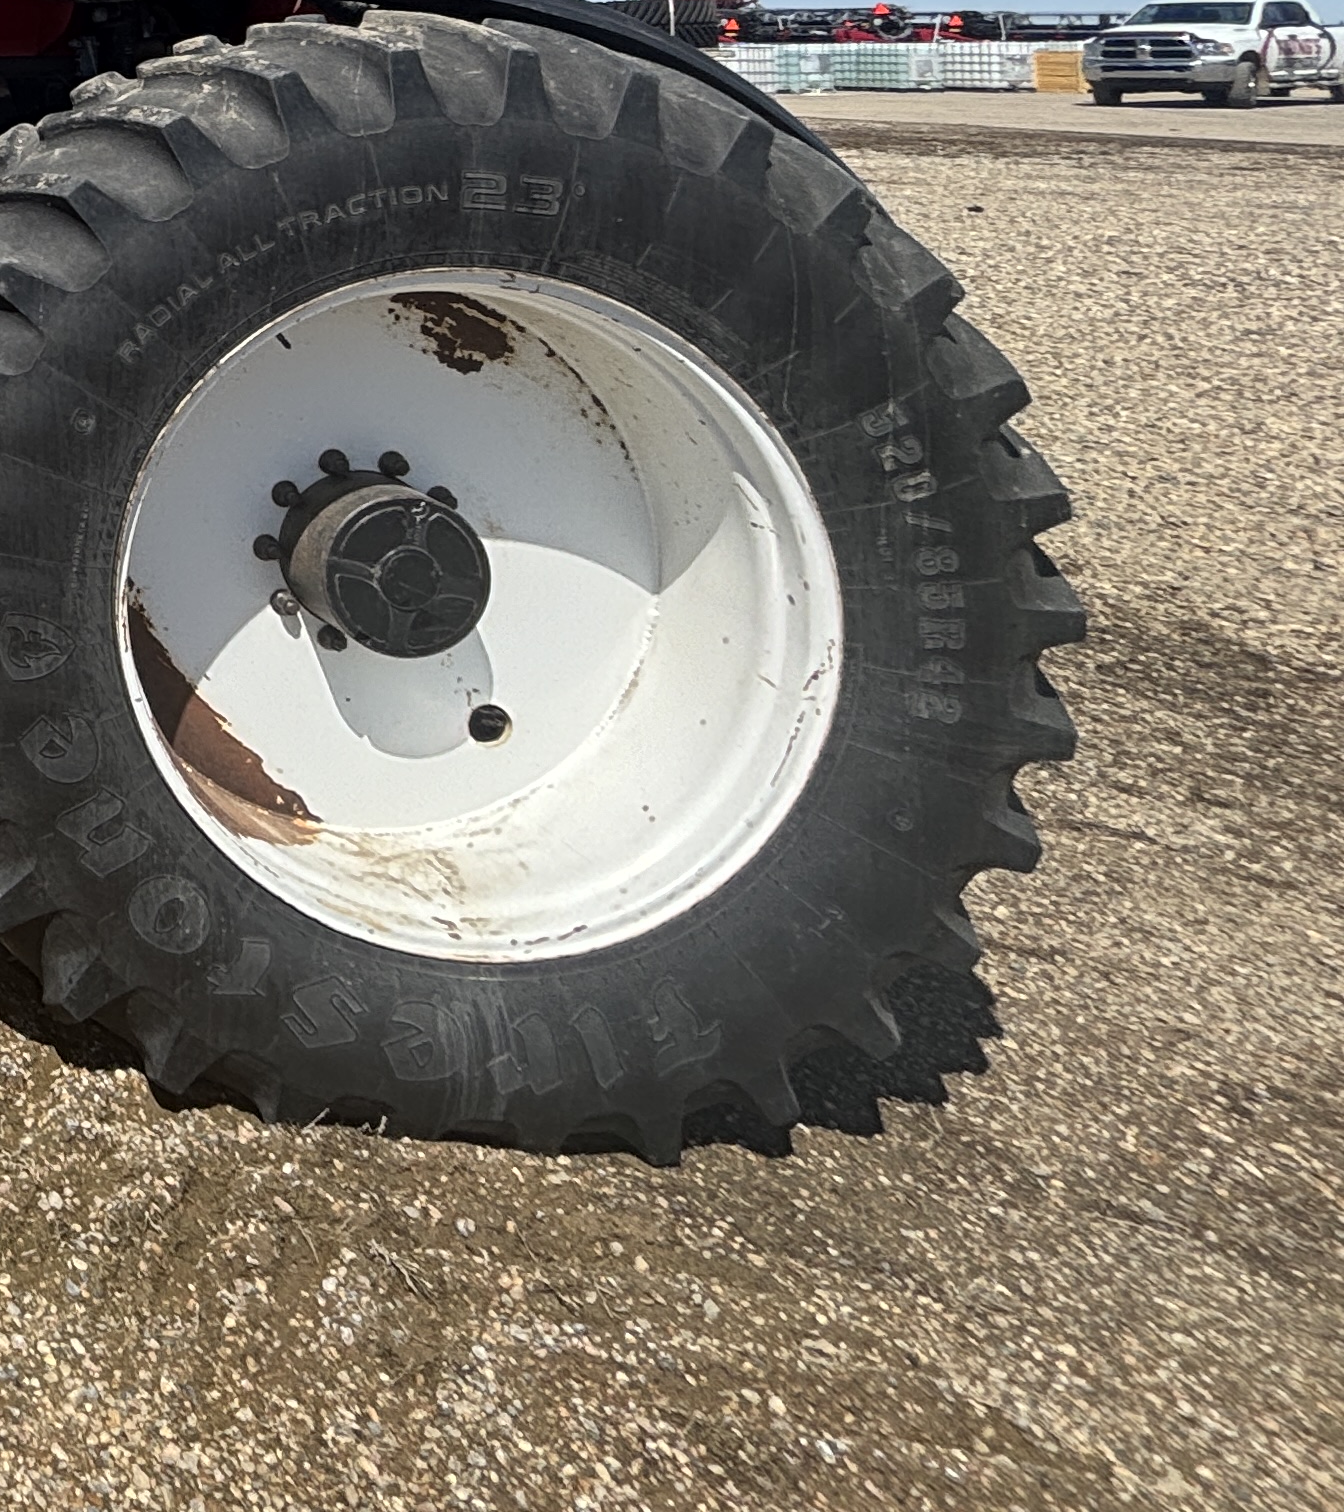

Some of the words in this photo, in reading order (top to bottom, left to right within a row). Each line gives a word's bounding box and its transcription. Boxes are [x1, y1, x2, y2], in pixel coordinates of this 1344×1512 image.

[115, 273, 214, 365] RADIAL
[216, 232, 276, 274] ALL
[274, 184, 450, 238] TRACTION
[858, 396, 967, 726] 520/85R42
[17, 710, 723, 1095] Firestone
